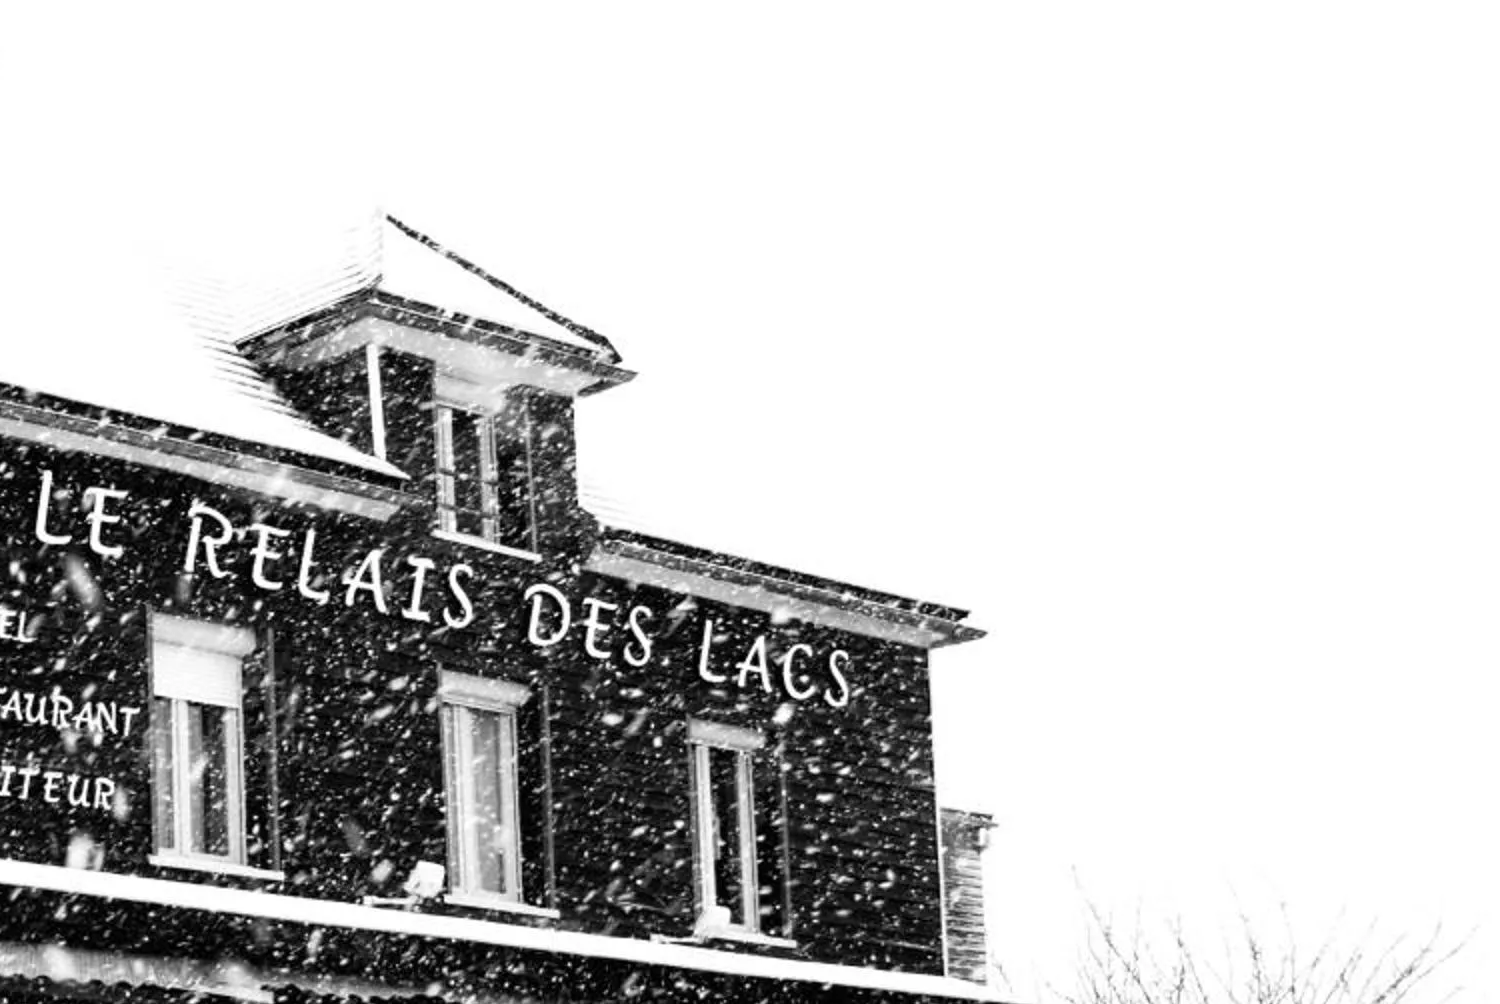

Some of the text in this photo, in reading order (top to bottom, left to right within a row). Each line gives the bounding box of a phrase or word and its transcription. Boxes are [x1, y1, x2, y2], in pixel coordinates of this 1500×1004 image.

[36, 471, 850, 707] LE RELAIS DES LACS
